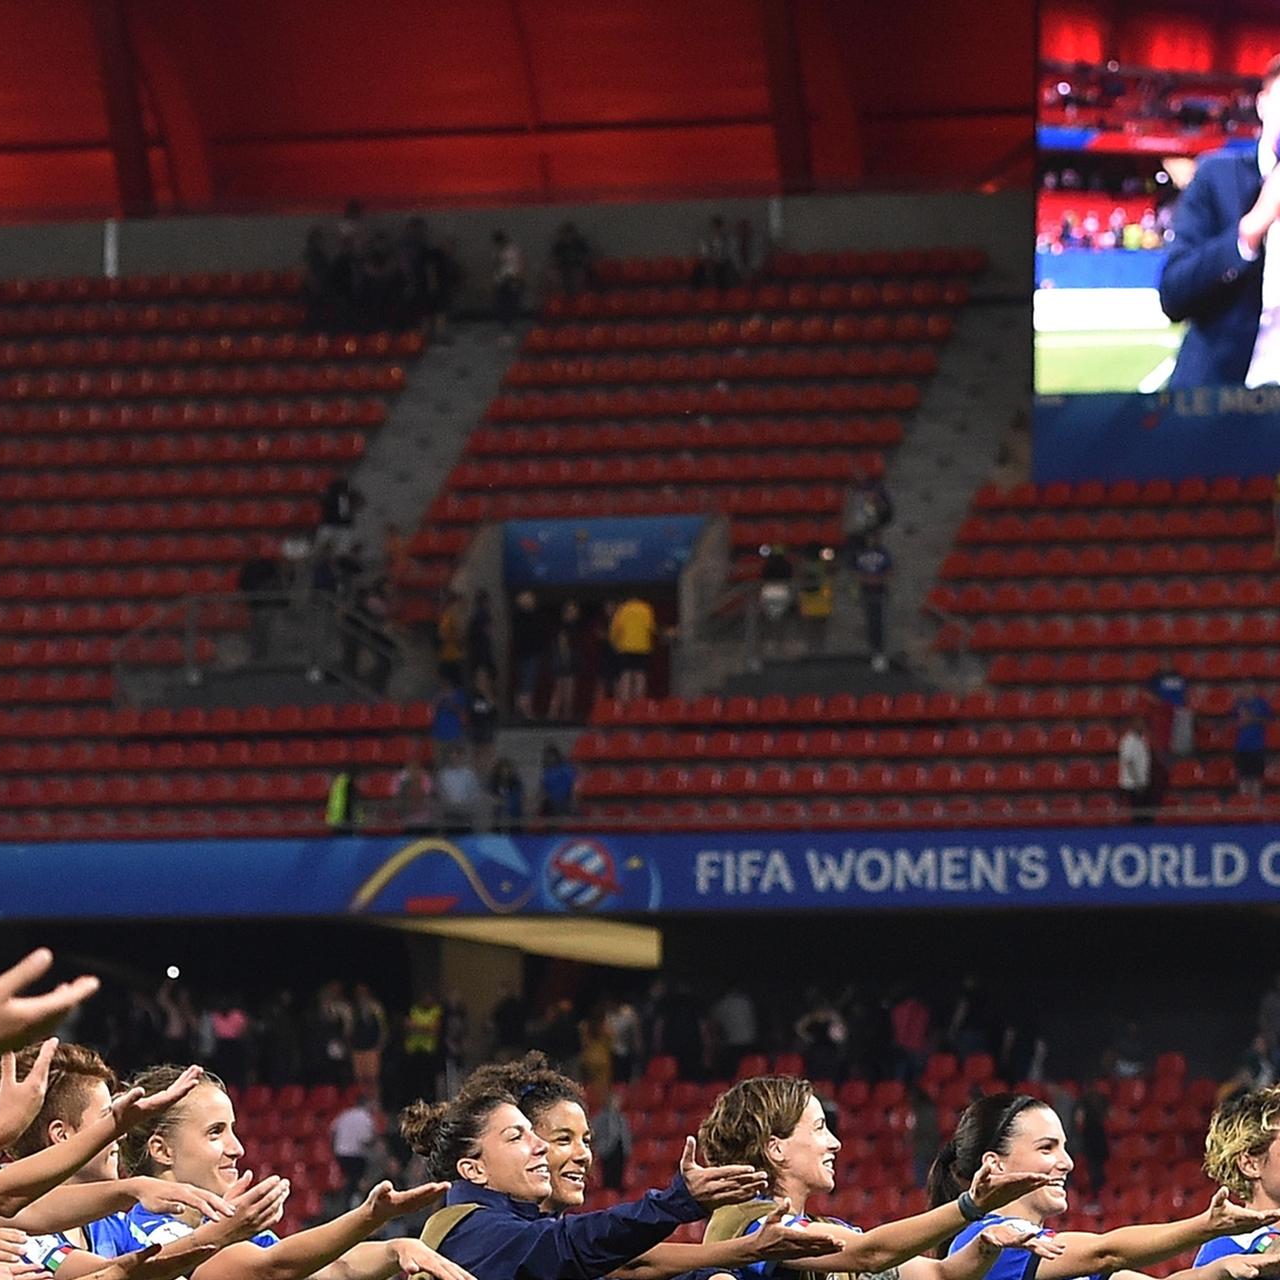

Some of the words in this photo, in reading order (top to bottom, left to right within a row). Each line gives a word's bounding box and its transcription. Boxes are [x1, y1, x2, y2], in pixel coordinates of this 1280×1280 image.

[695, 851, 793, 892] FIFA
[807, 846, 1049, 891] WOMEN'S
[1061, 844, 1248, 887] WORLD
